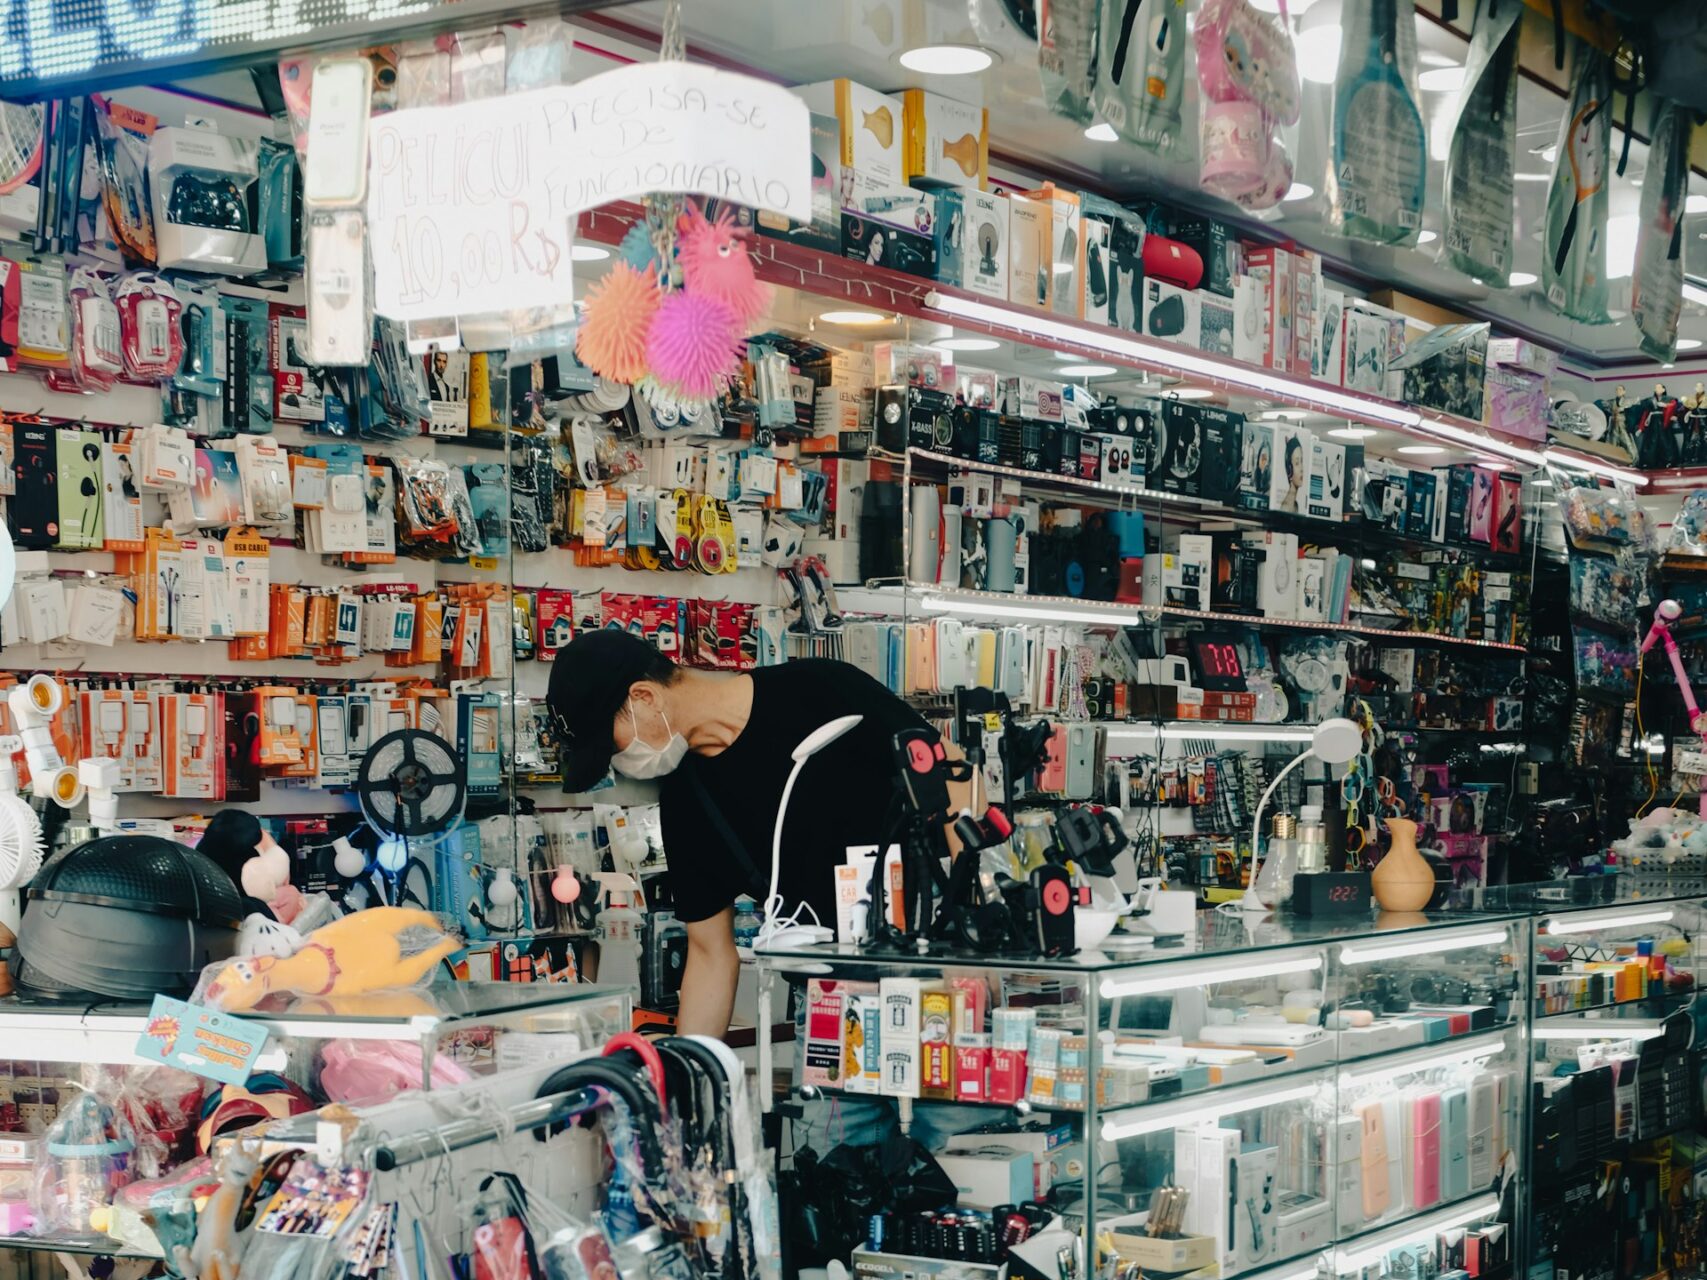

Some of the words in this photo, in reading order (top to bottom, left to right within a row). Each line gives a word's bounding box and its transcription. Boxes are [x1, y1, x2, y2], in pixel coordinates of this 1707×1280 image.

[910, 420, 933, 435] X-BASS
[234, 543, 246, 552] USB
[247, 543, 267, 552] CABLE
[840, 886, 857, 898] CAR
